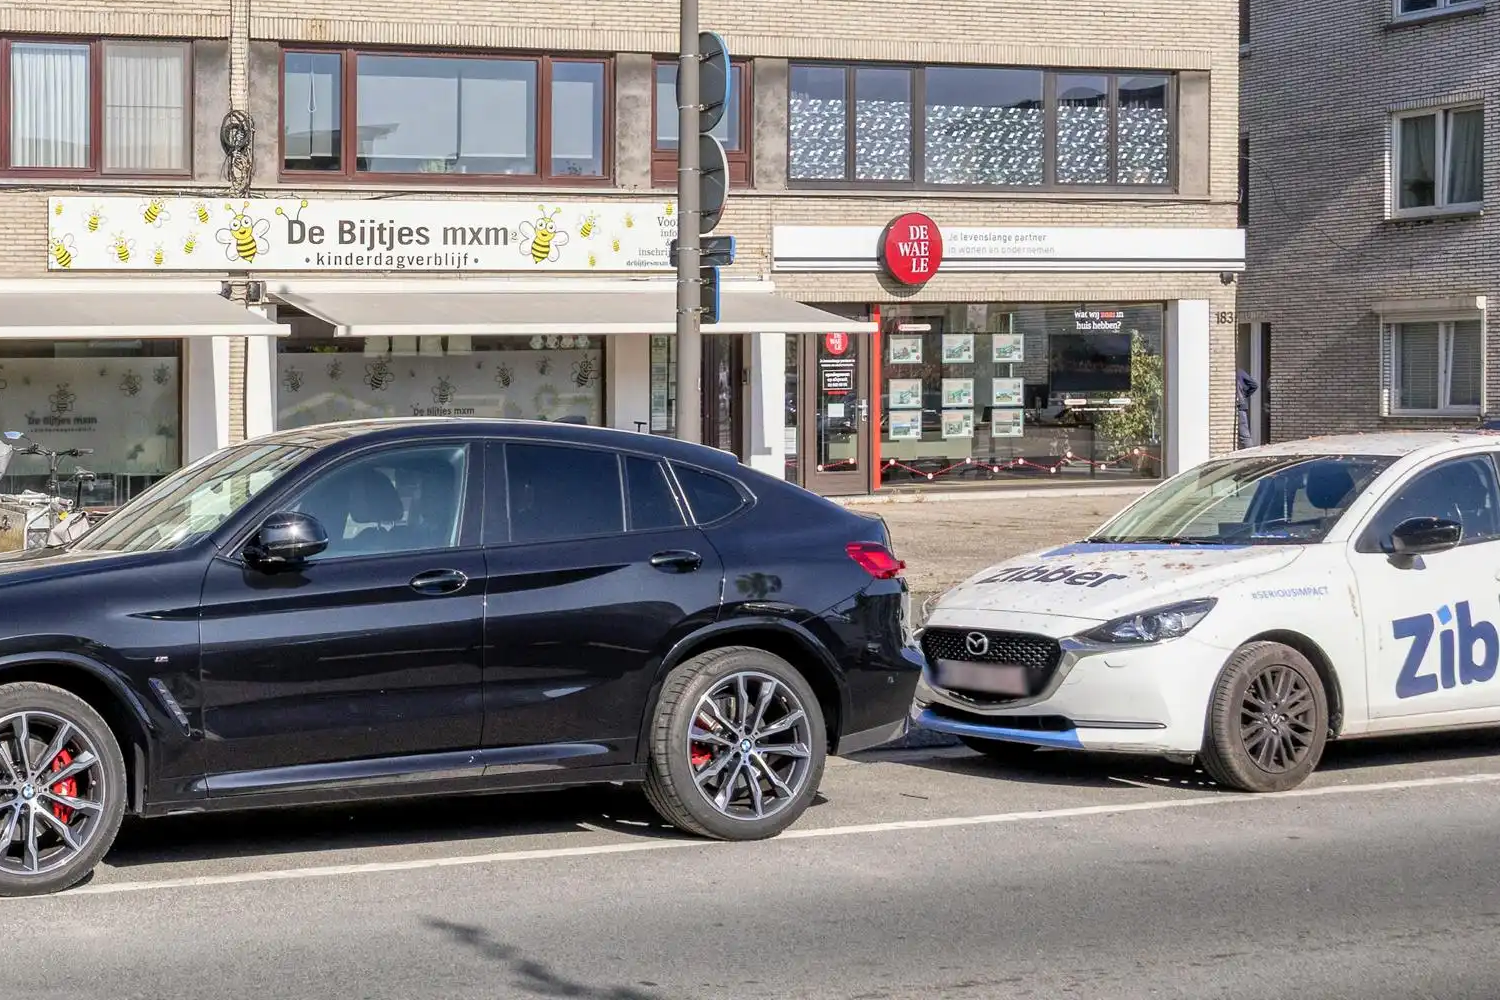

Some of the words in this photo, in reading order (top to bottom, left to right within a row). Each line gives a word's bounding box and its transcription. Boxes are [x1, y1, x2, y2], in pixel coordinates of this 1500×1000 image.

[657, 216, 678, 227] Voo
[287, 219, 325, 245] De
[338, 219, 430, 251] Bijtjes
[442, 226, 509, 246] mxm
[909, 225, 929, 240] DE
[960, 232, 1012, 243] levenslange
[1014, 233, 1047, 243] partner
[898, 241, 929, 257] WAE
[316, 252, 469, 269] kinderdagverblijf
[911, 258, 929, 273] LE
[1092, 321, 1122, 330] hebben?
[1215, 311, 1234, 325] 183
[974, 565, 1128, 588] Zibber
[1392, 600, 1500, 699] Zib
